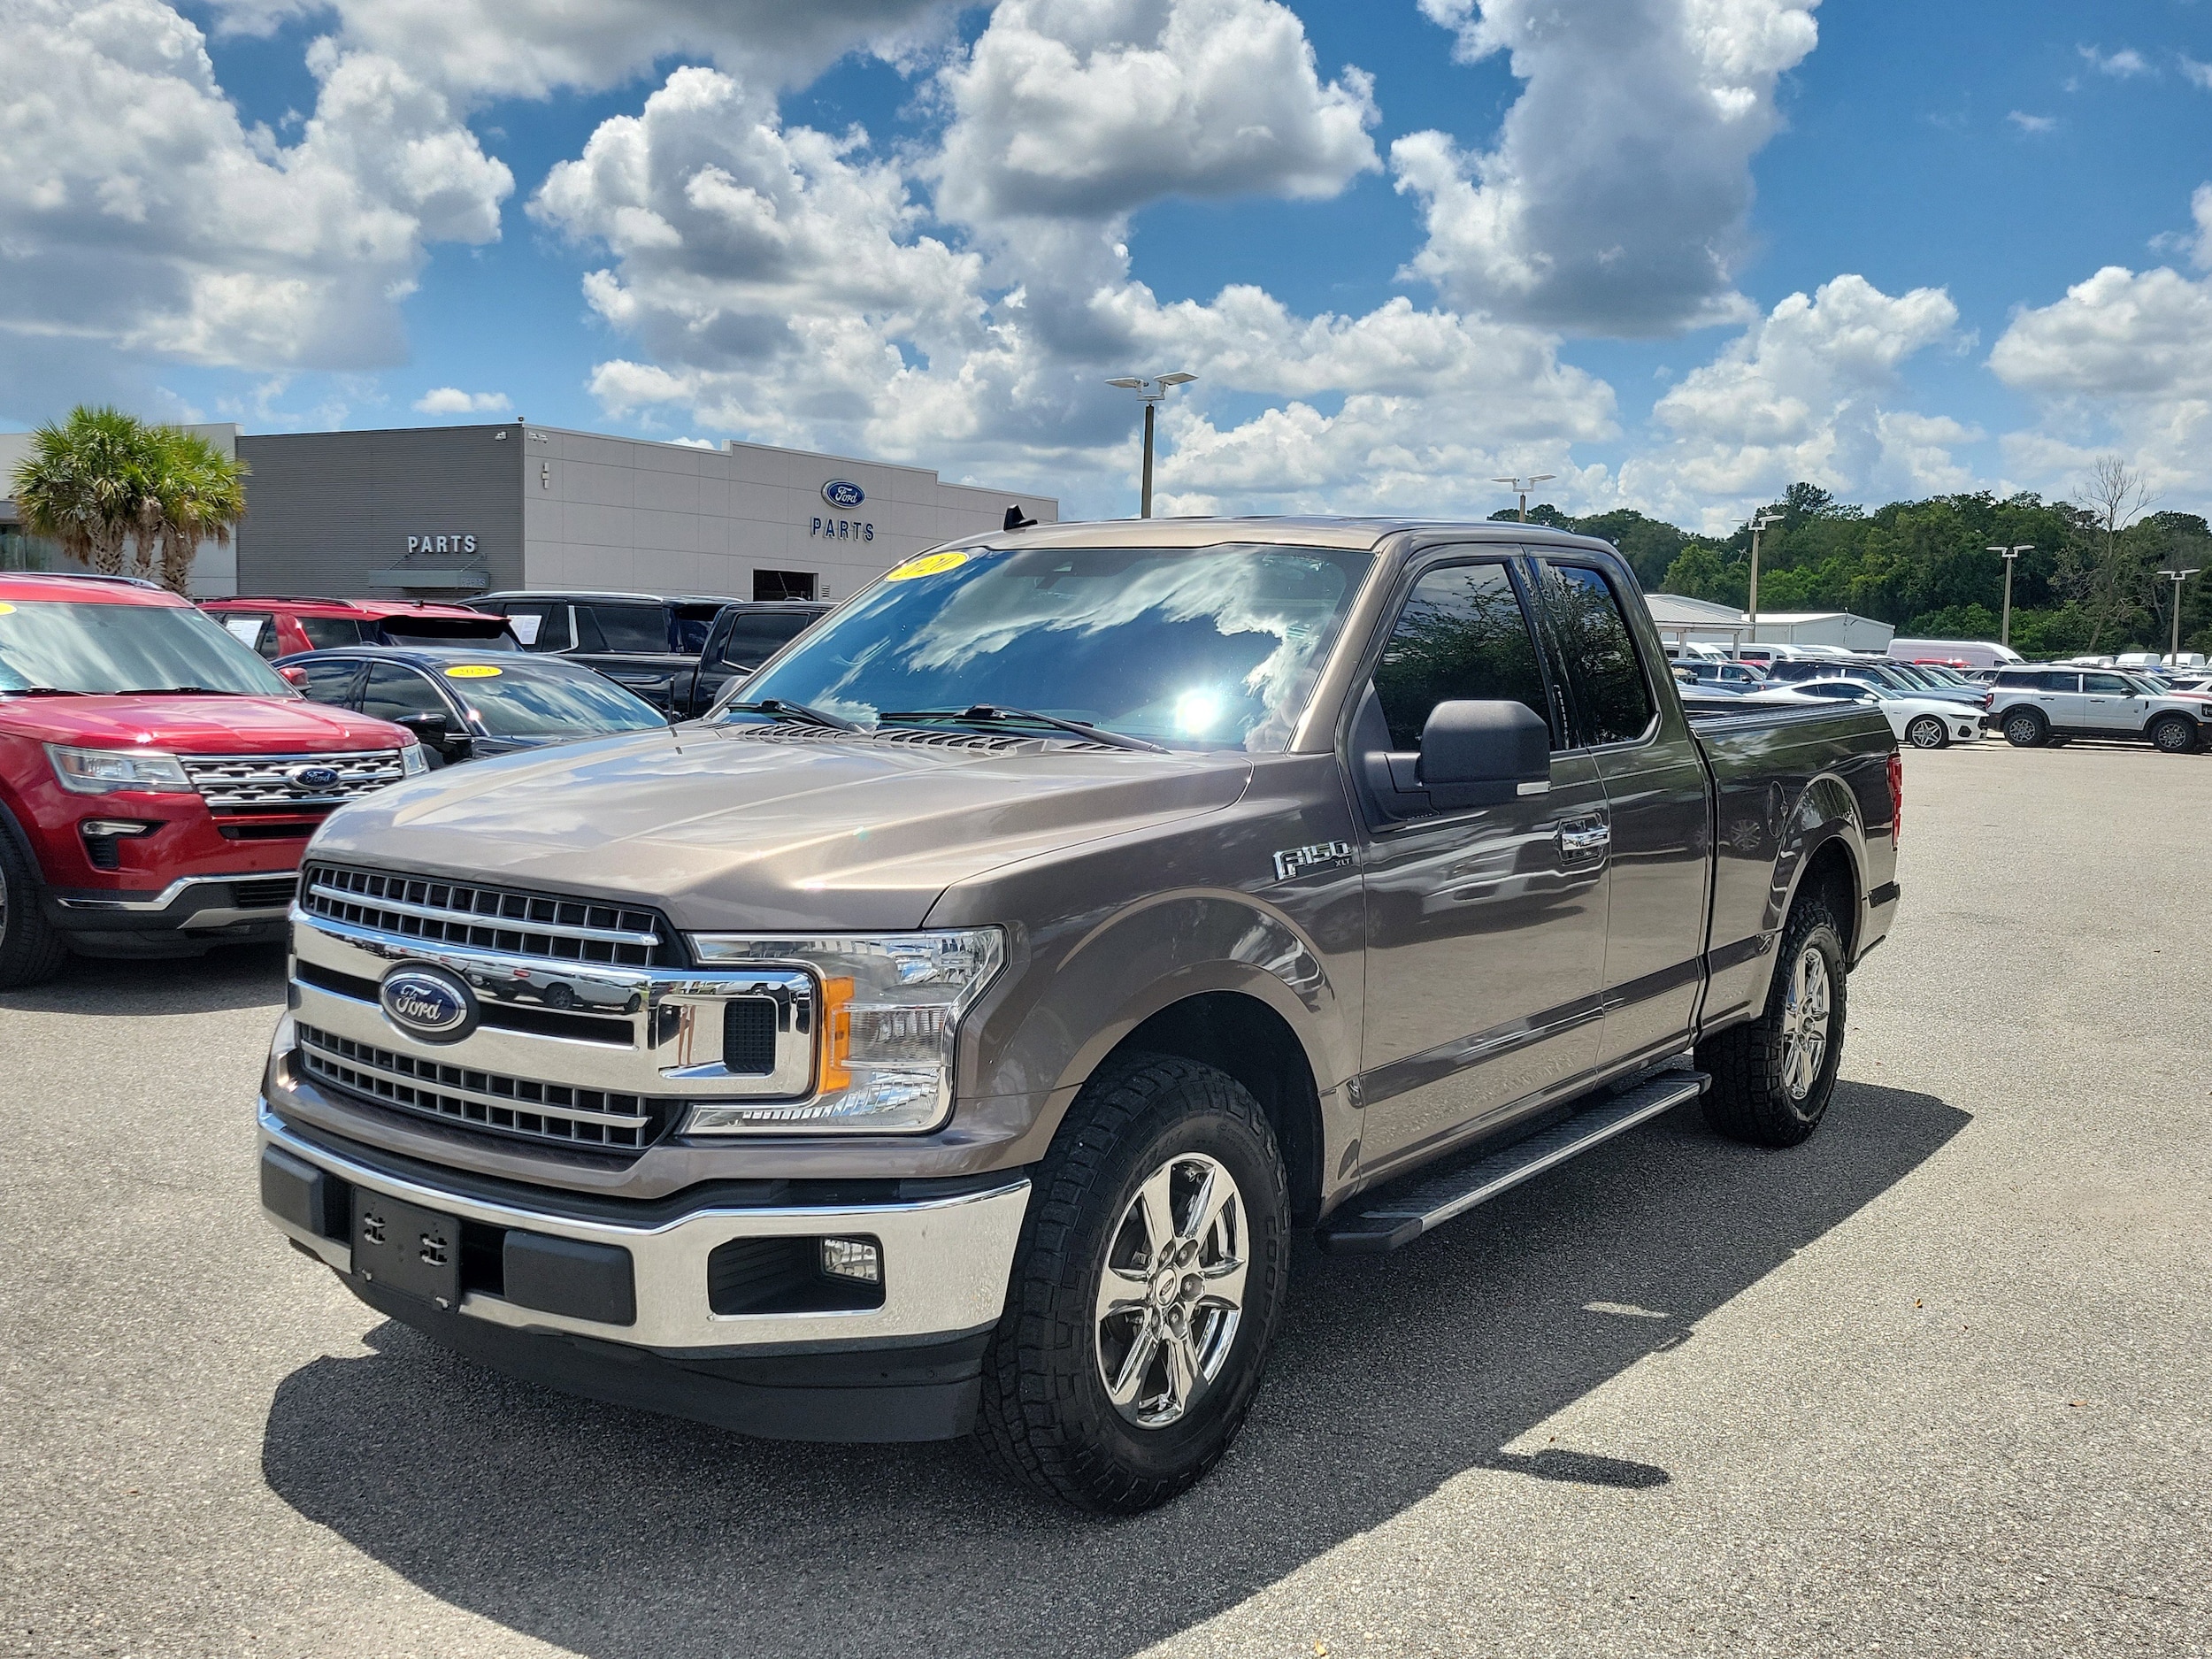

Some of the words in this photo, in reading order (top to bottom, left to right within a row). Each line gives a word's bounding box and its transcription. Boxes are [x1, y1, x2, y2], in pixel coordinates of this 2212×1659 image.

[834, 486, 858, 503] Ford
[810, 517, 874, 542] PARTS
[407, 534, 477, 554] PARTS
[305, 771, 332, 783] Ford
[1334, 858, 1351, 867] XLT
[396, 984, 443, 1021] Ford
